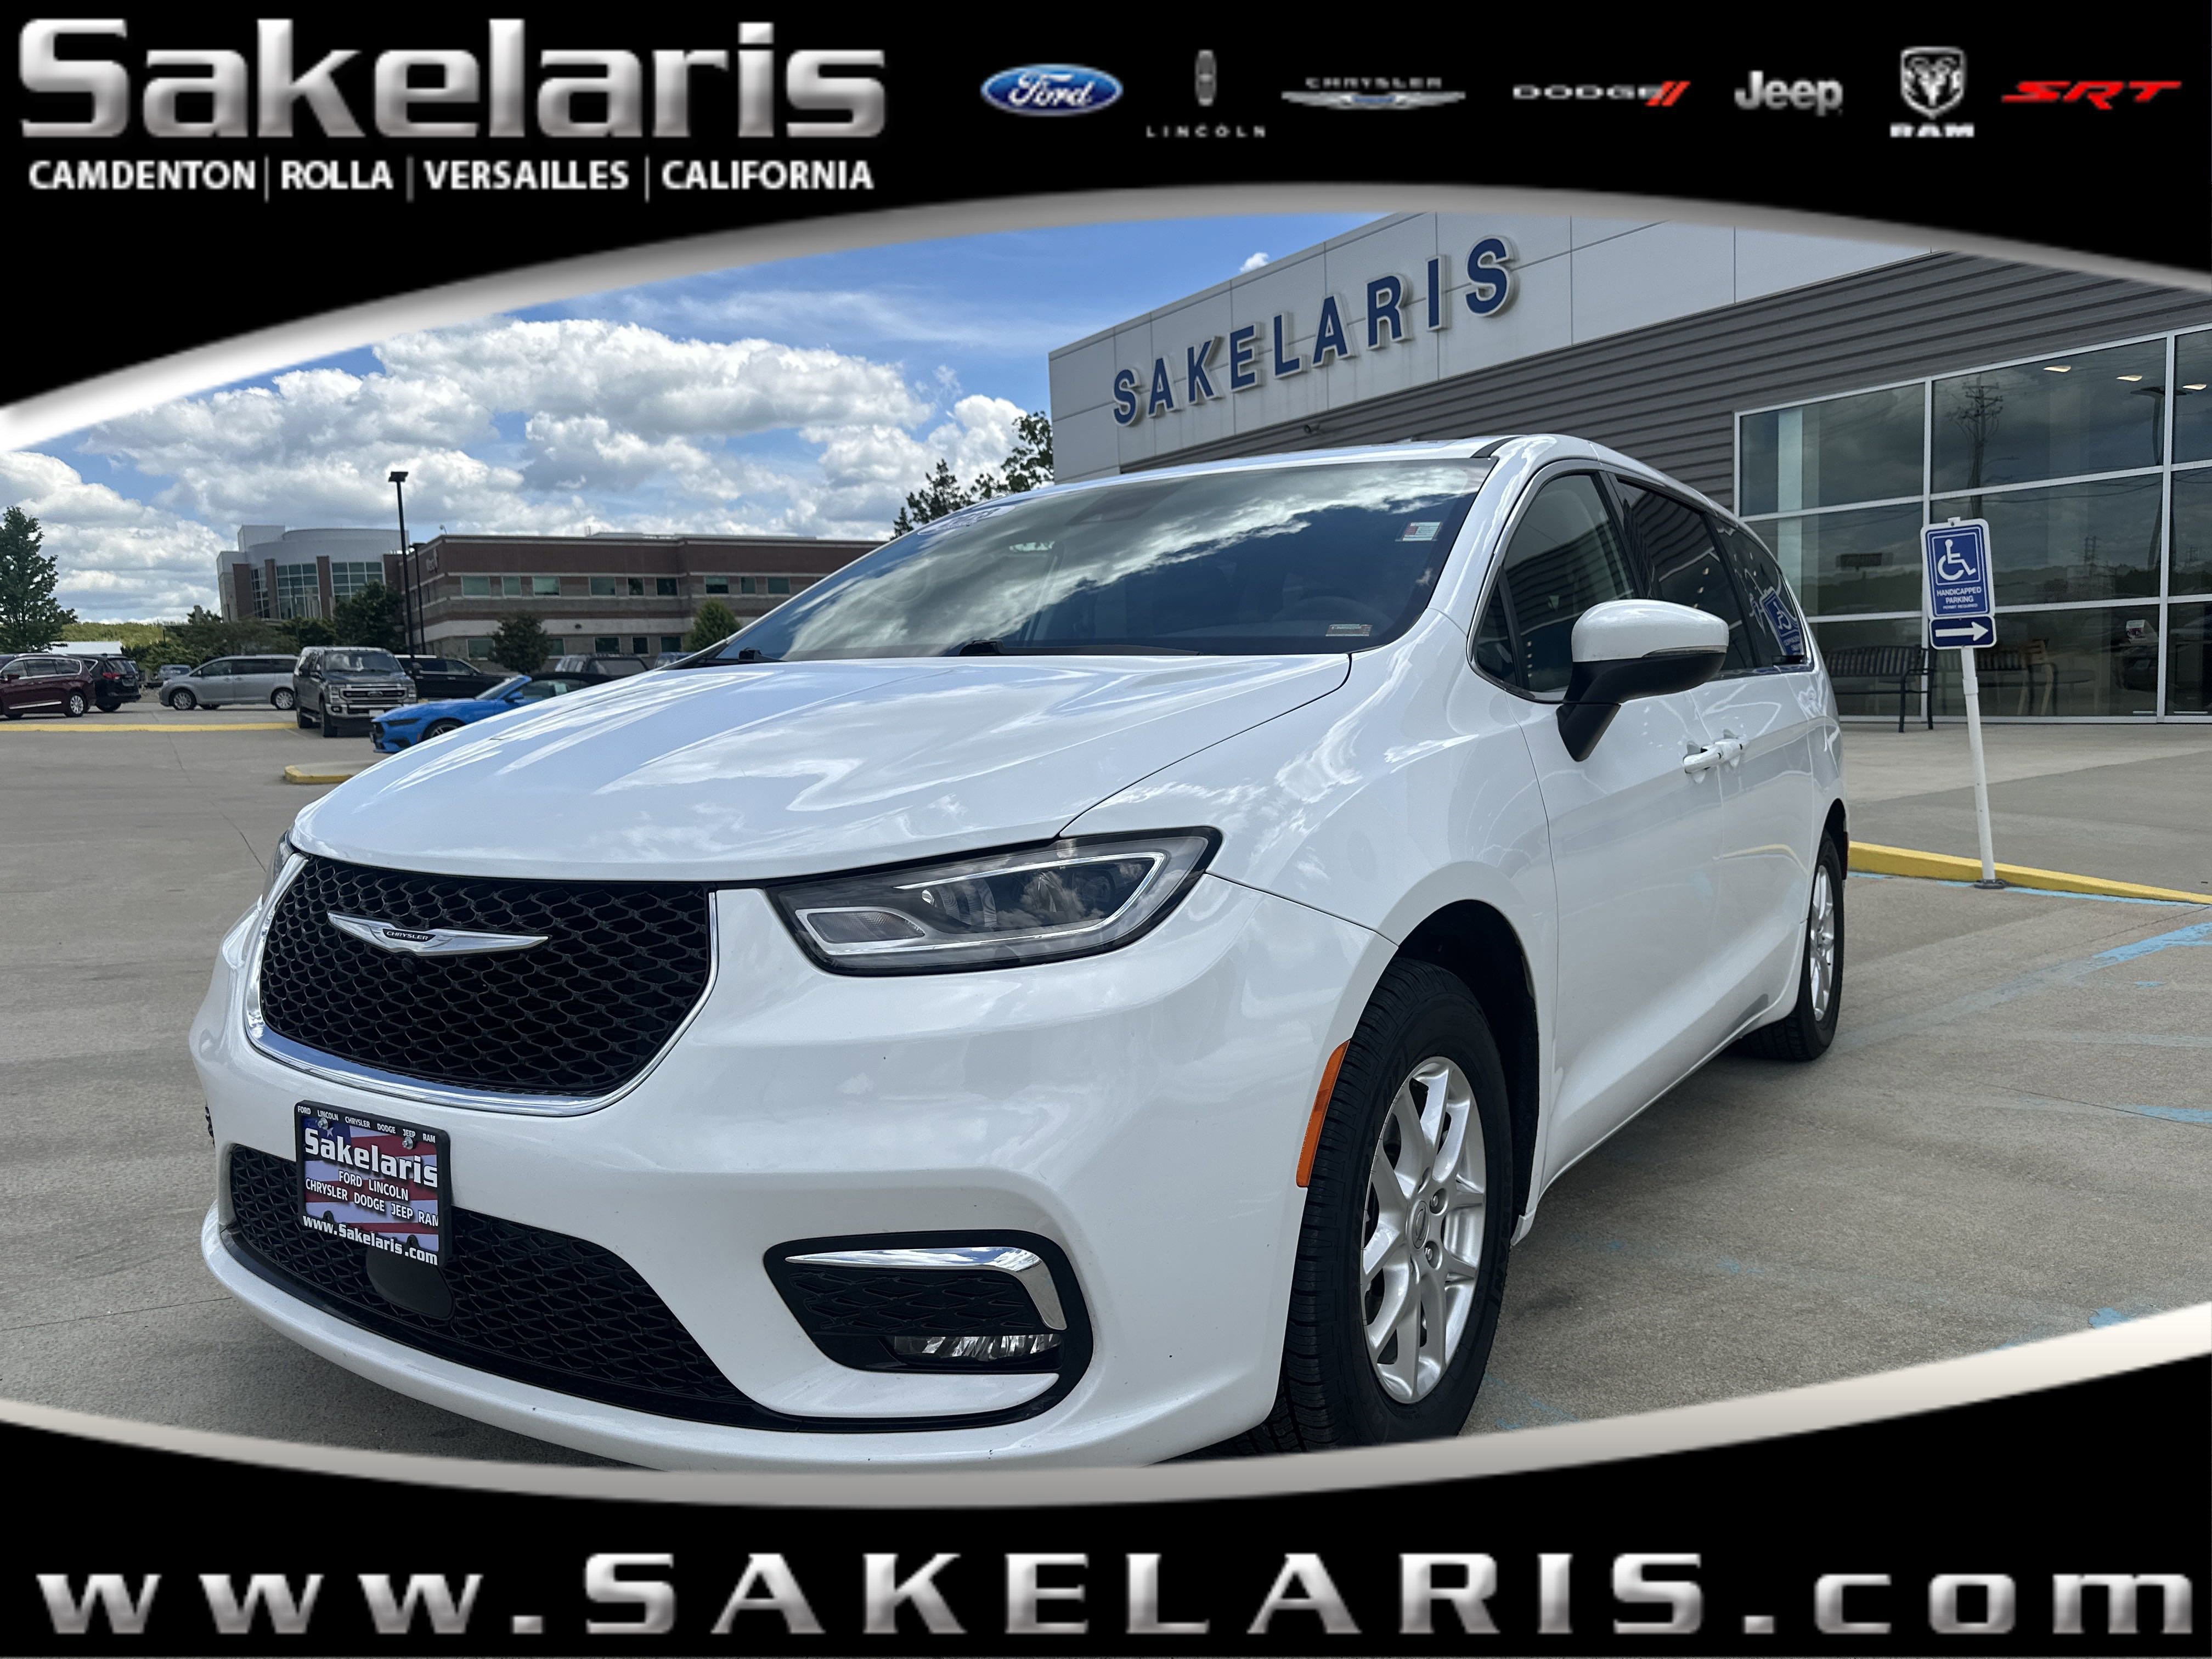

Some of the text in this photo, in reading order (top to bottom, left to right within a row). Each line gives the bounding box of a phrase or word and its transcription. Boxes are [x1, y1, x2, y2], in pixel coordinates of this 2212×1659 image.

[1113, 237, 1513, 426] SAKELARIS
[1937, 586, 1981, 596] HANDICAPPED
[1945, 595, 1973, 603] PARKING
[386, 932, 428, 940] CHRYSLER
[297, 1105, 436, 1143] FORD LINCOLN CHRYSLER DODGE JEEP RAM
[304, 1127, 438, 1188] Sakelaris
[305, 1178, 348, 1201] CHRYSLER
[354, 1192, 385, 1212] DODGE
[391, 1203, 413, 1220] JEEP
[338, 1170, 409, 1201] FORD LINCOLN
